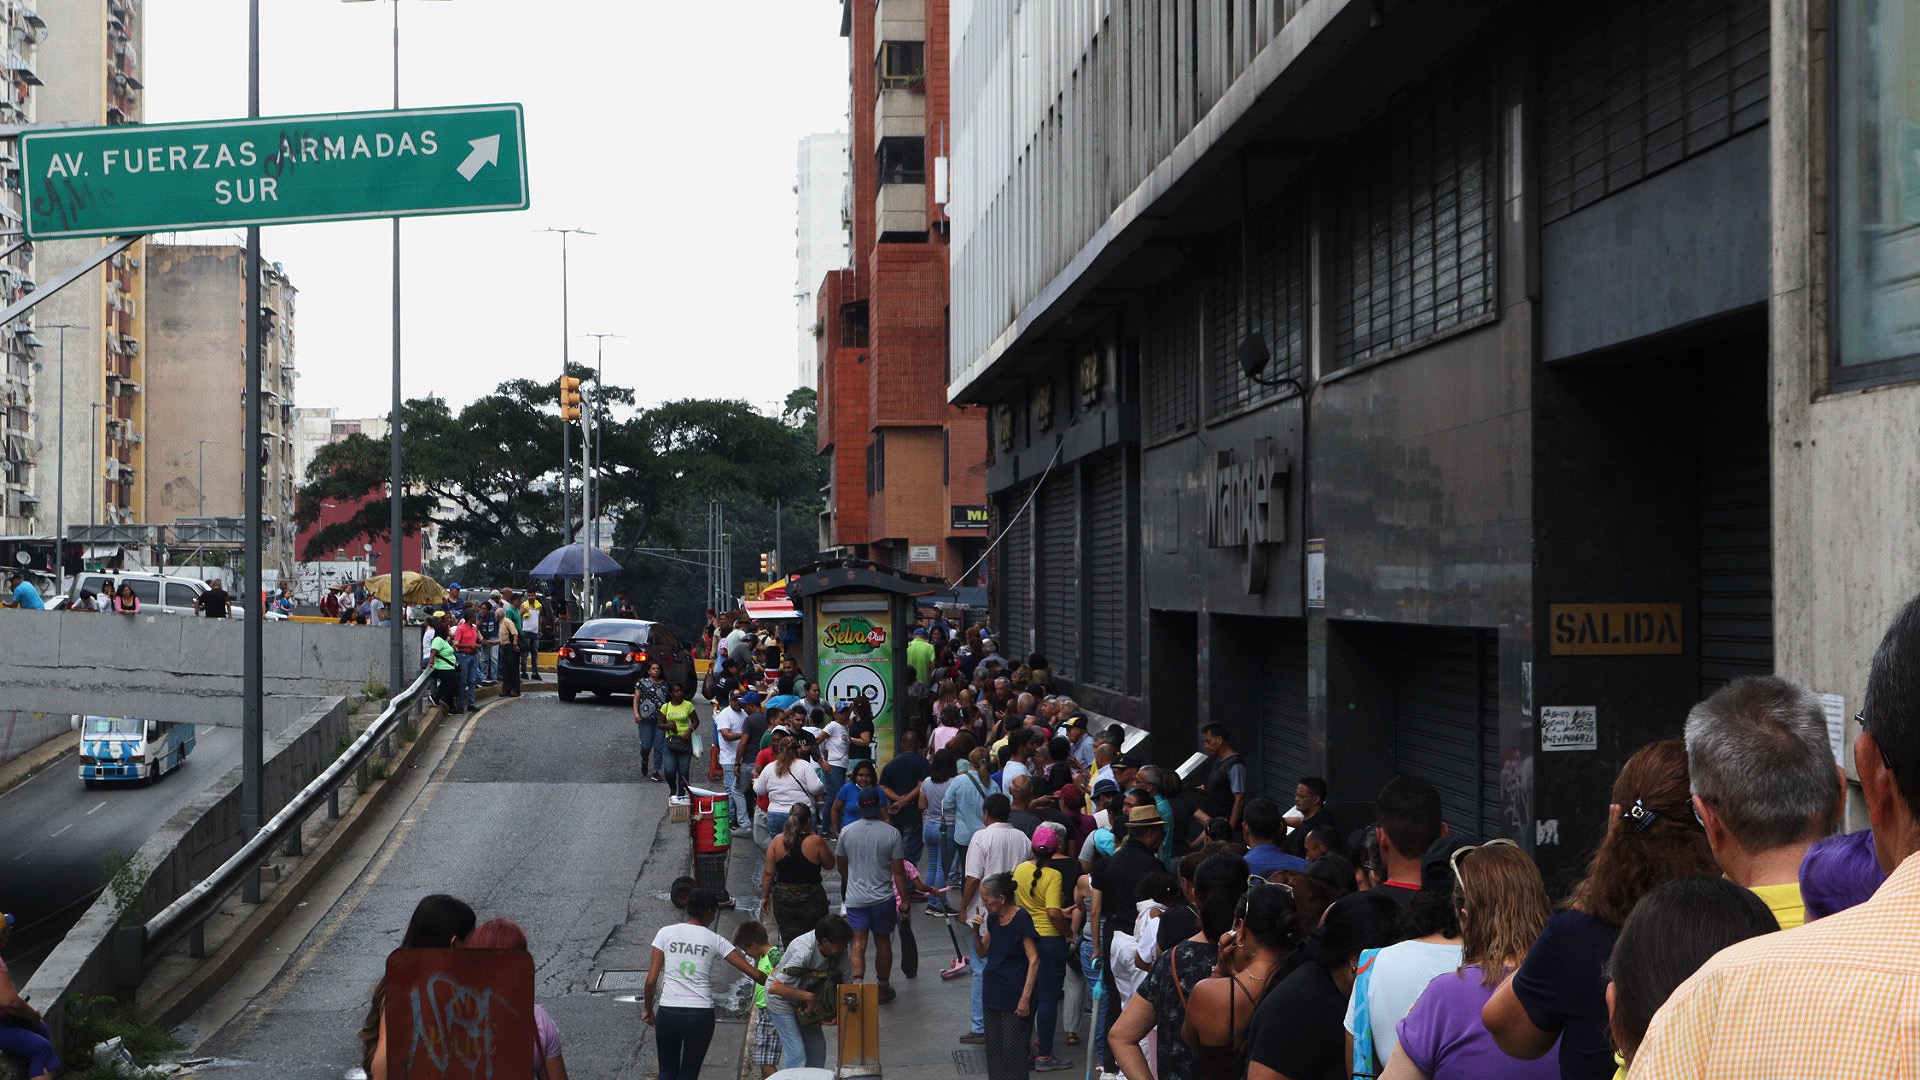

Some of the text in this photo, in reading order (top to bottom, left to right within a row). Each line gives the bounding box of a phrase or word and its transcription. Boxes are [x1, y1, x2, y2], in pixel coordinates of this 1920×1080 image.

[46, 152, 89, 178] AV.
[103, 141, 258, 175] FUERZAS
[276, 130, 439, 164] ARMADAS
[214, 177, 279, 205] SUR
[1205, 438, 1290, 595] Wrangler
[824, 623, 885, 648] Selva Plus
[1556, 612, 1678, 644] SALIDA
[833, 685, 879, 702] LDO
[669, 941, 710, 957] STAFF
